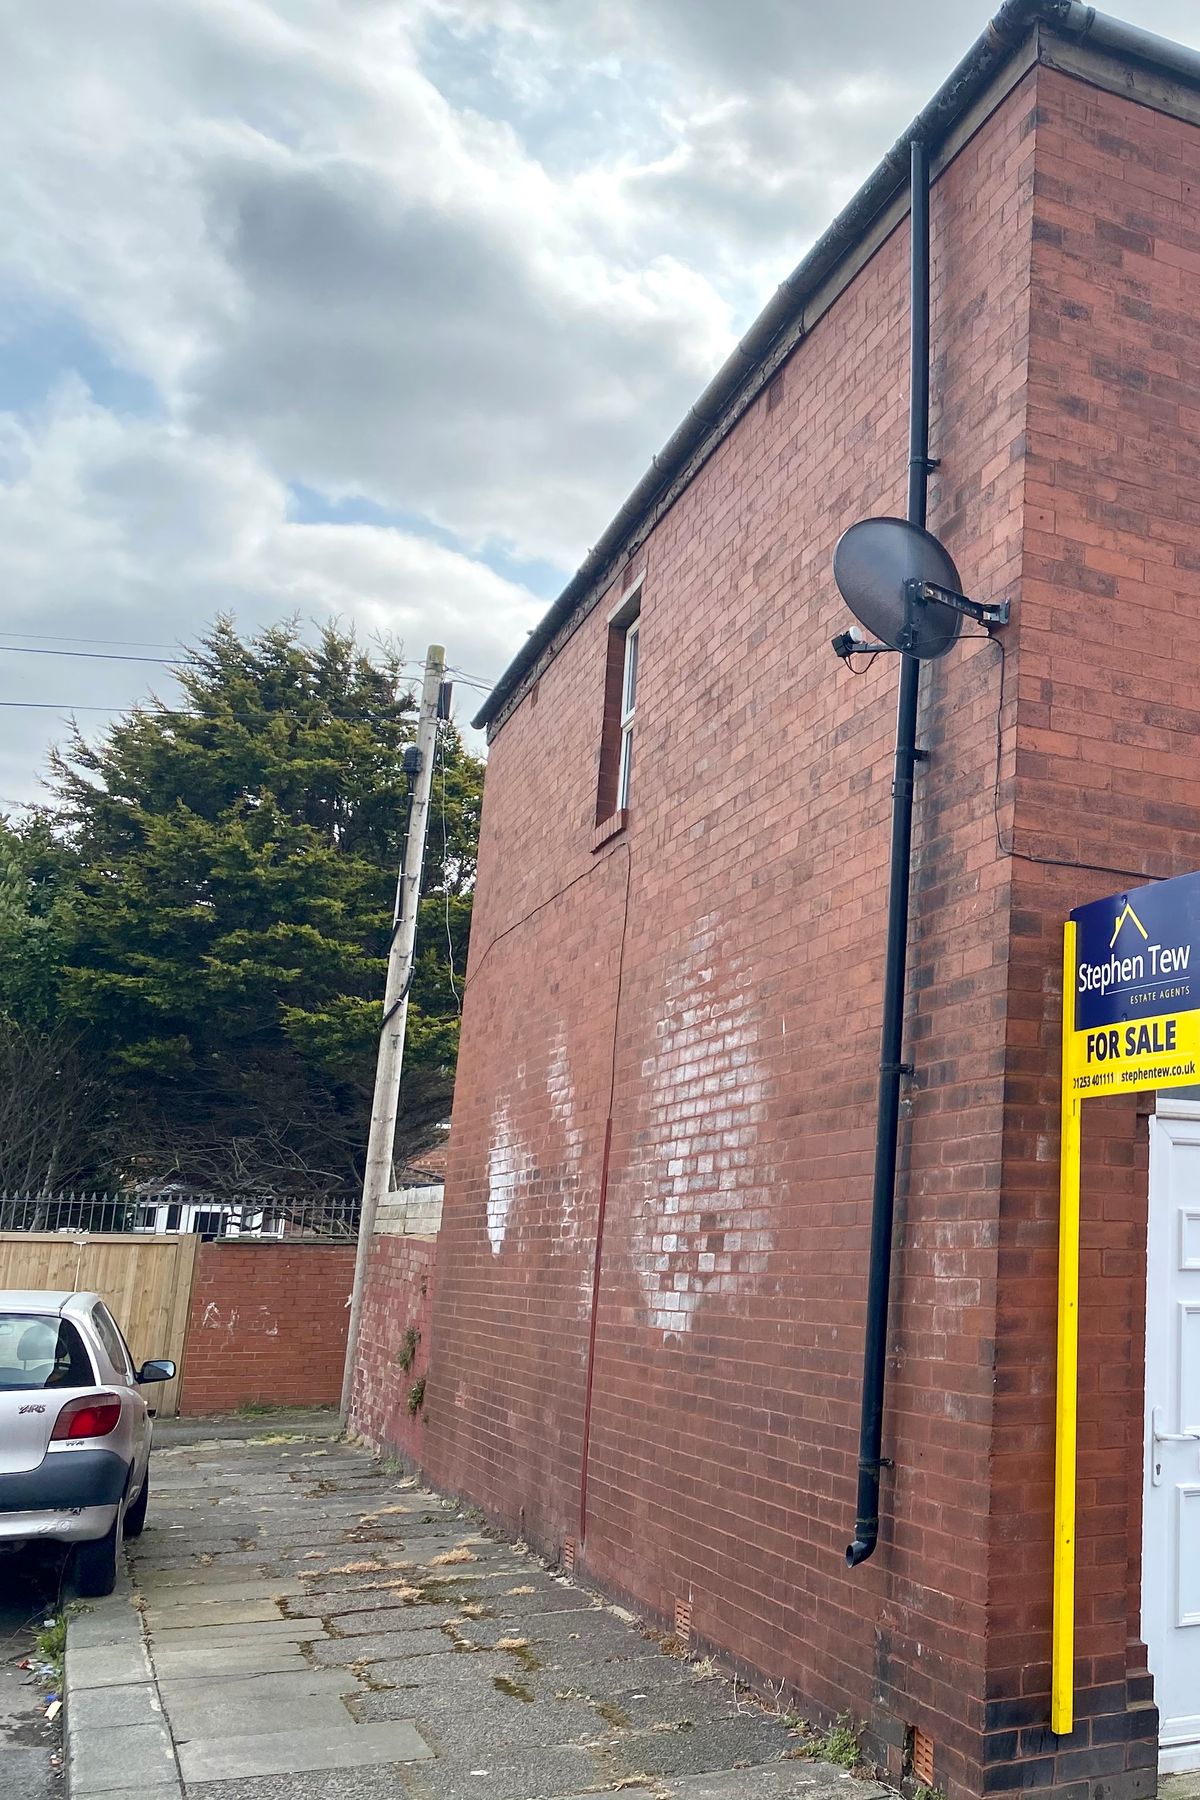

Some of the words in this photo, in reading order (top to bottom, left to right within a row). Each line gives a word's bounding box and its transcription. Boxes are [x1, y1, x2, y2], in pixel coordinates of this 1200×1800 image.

[1078, 953, 1144, 996] Stephen
[1148, 944, 1191, 976] Tew
[1130, 991, 1156, 1005] ESTATE
[1159, 985, 1190, 999] AGENTS
[1087, 1029, 1120, 1063] FOR
[1125, 1020, 1176, 1057] SALE
[1091, 1072, 1114, 1087] 401111
[1121, 1061, 1196, 1084] stephentew.co.uk
